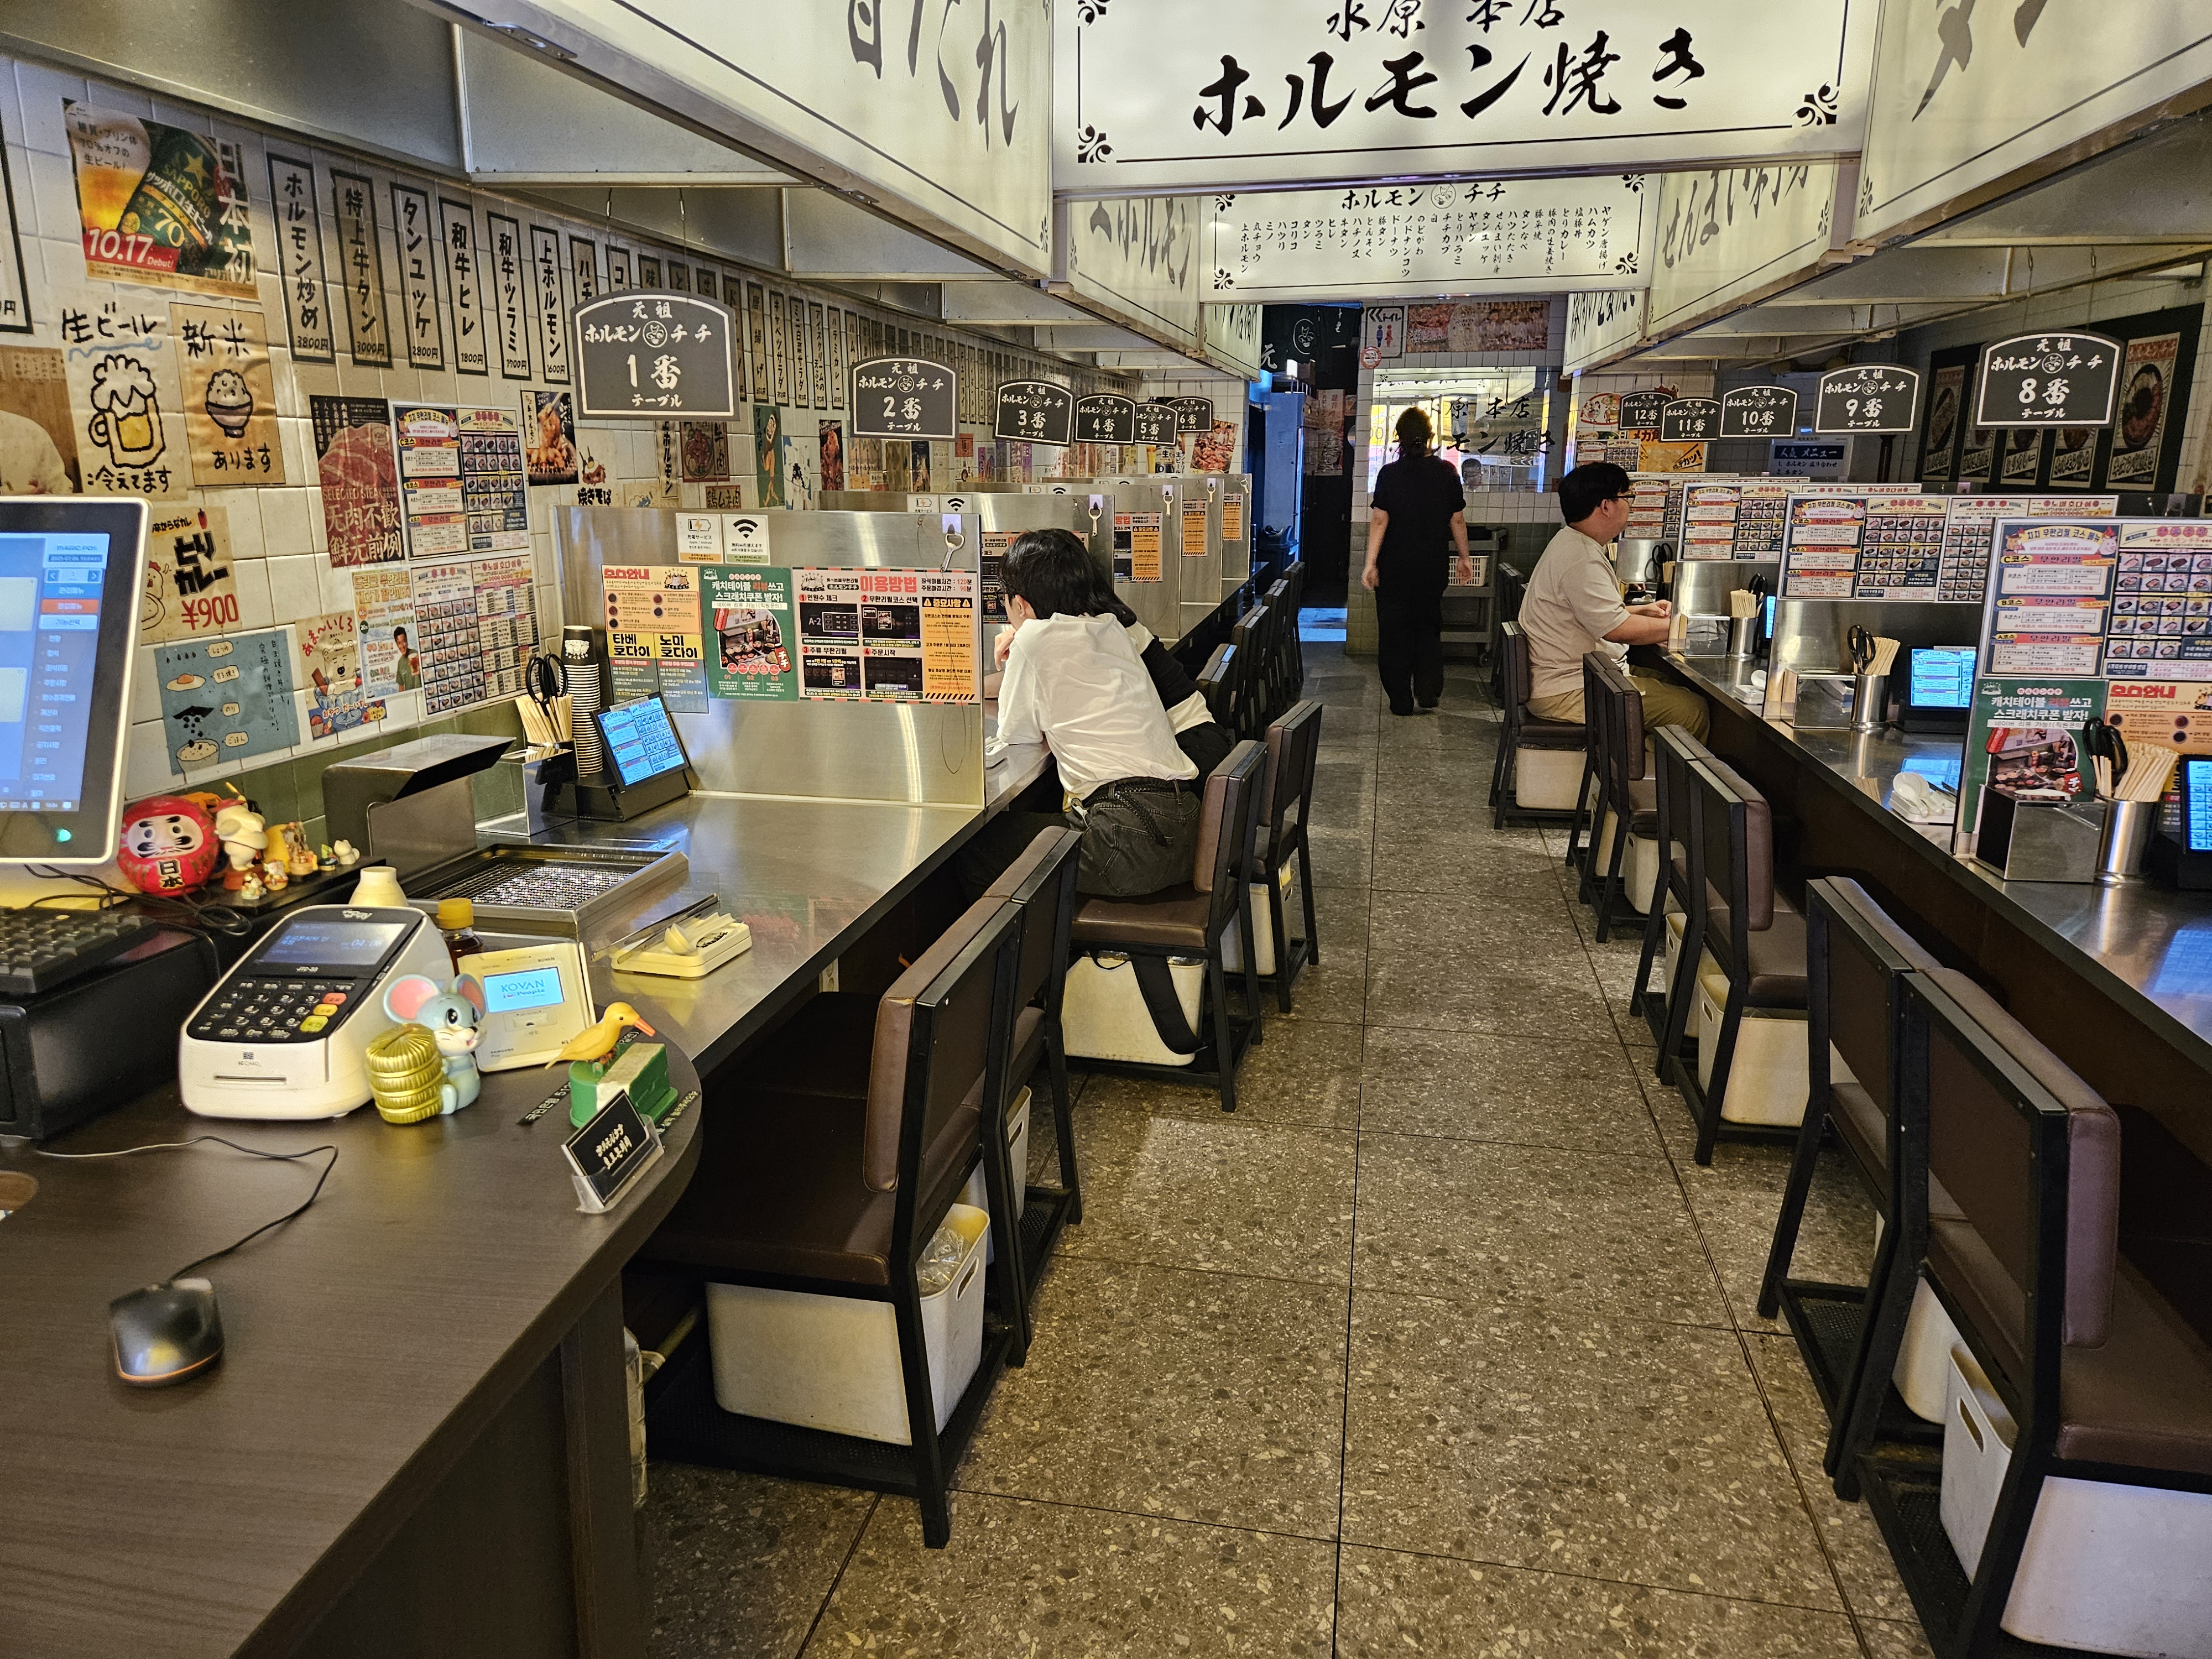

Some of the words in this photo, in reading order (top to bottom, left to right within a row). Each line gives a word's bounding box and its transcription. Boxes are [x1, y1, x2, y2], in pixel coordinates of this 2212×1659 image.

[1193, 27, 1704, 136] ホルモン焼き
[1342, 187, 1425, 210] ホルモン
[1464, 182, 1506, 204] チチ
[1265, 223, 1274, 241] ミノ
[1302, 220, 1311, 239] タン
[1314, 220, 1324, 250] ツラミ
[1328, 219, 1337, 238] ヒレ
[1468, 212, 1478, 243] ヤゲン
[1585, 207, 1599, 250] ハムカツ
[1352, 217, 1362, 259] ハチノス
[88, 228, 154, 264] 10.17
[147, 257, 175, 268] Debut!
[284, 172, 319, 330] ホルモン炒め
[1241, 223, 1249, 273] 上ホルモン
[345, 187, 377, 334] 特上牛タン
[403, 196, 431, 338] タンユッケ
[451, 221, 476, 337] 和牛ヒレ
[498, 232, 518, 353] 和牛ツラミ
[540, 239, 561, 358] 上ホルモン
[633, 301, 672, 319] 元祖
[62, 301, 158, 343] 生ビール
[182, 319, 250, 358] 新米
[585, 324, 640, 343] ホルモン
[671, 324, 712, 343] チチ
[296, 335, 329, 352] 3800円
[356, 340, 385, 356] 3000円
[2037, 338, 2072, 352] 元祖
[411, 346, 439, 360] 2800円
[460, 352, 484, 365] 1800円
[891, 362, 918, 374] 元祖
[1991, 356, 2042, 371] ホルモン
[2067, 354, 2103, 369] チチ
[627, 354, 681, 389] 1番
[1858, 369, 1883, 379] 元祖
[859, 375, 896, 388] ホルモン
[916, 378, 943, 390] チチ
[1026, 385, 1046, 395] 元祖
[1825, 383, 1861, 394] ホルモン
[1880, 381, 1906, 392] チチ
[2019, 378, 2070, 405] 8番
[632, 394, 682, 407] テーブル
[883, 396, 921, 420] 2番
[1001, 393, 1029, 404] ホルモン
[1044, 399, 1063, 408] チチ
[1726, 398, 1754, 407] ホルモン
[1769, 398, 1788, 406] チチ
[1846, 398, 1883, 418] 9番
[1079, 405, 1101, 414] ホルモン
[1635, 410, 1658, 420] 12番
[1742, 410, 1775, 426] 10番
[2022, 408, 2065, 419] テーブル
[887, 422, 921, 431] テーブル
[1018, 410, 1046, 429] 3番
[1093, 419, 1115, 432] 4番
[1679, 419, 1705, 431] 11番
[1019, 430, 1045, 438] テーブル
[1140, 422, 1160, 436] 5番
[212, 444, 271, 473] あります
[712, 581, 752, 591] 캐치테이블
[860, 576, 917, 592] 이용방법
[715, 592, 763, 602] 스크래치쿠폰
[764, 592, 783, 602] 받자!
[181, 593, 239, 630] ¥900
[612, 633, 637, 645] 타베
[660, 635, 684, 646] 노미
[1991, 696, 2046, 708] 캐치테이블
[1993, 709, 2060, 720] 스크래치쿠폰
[2062, 709, 2089, 721] 받자!
[159, 859, 185, 888] 日本
[501, 979, 545, 993] KOVAN
